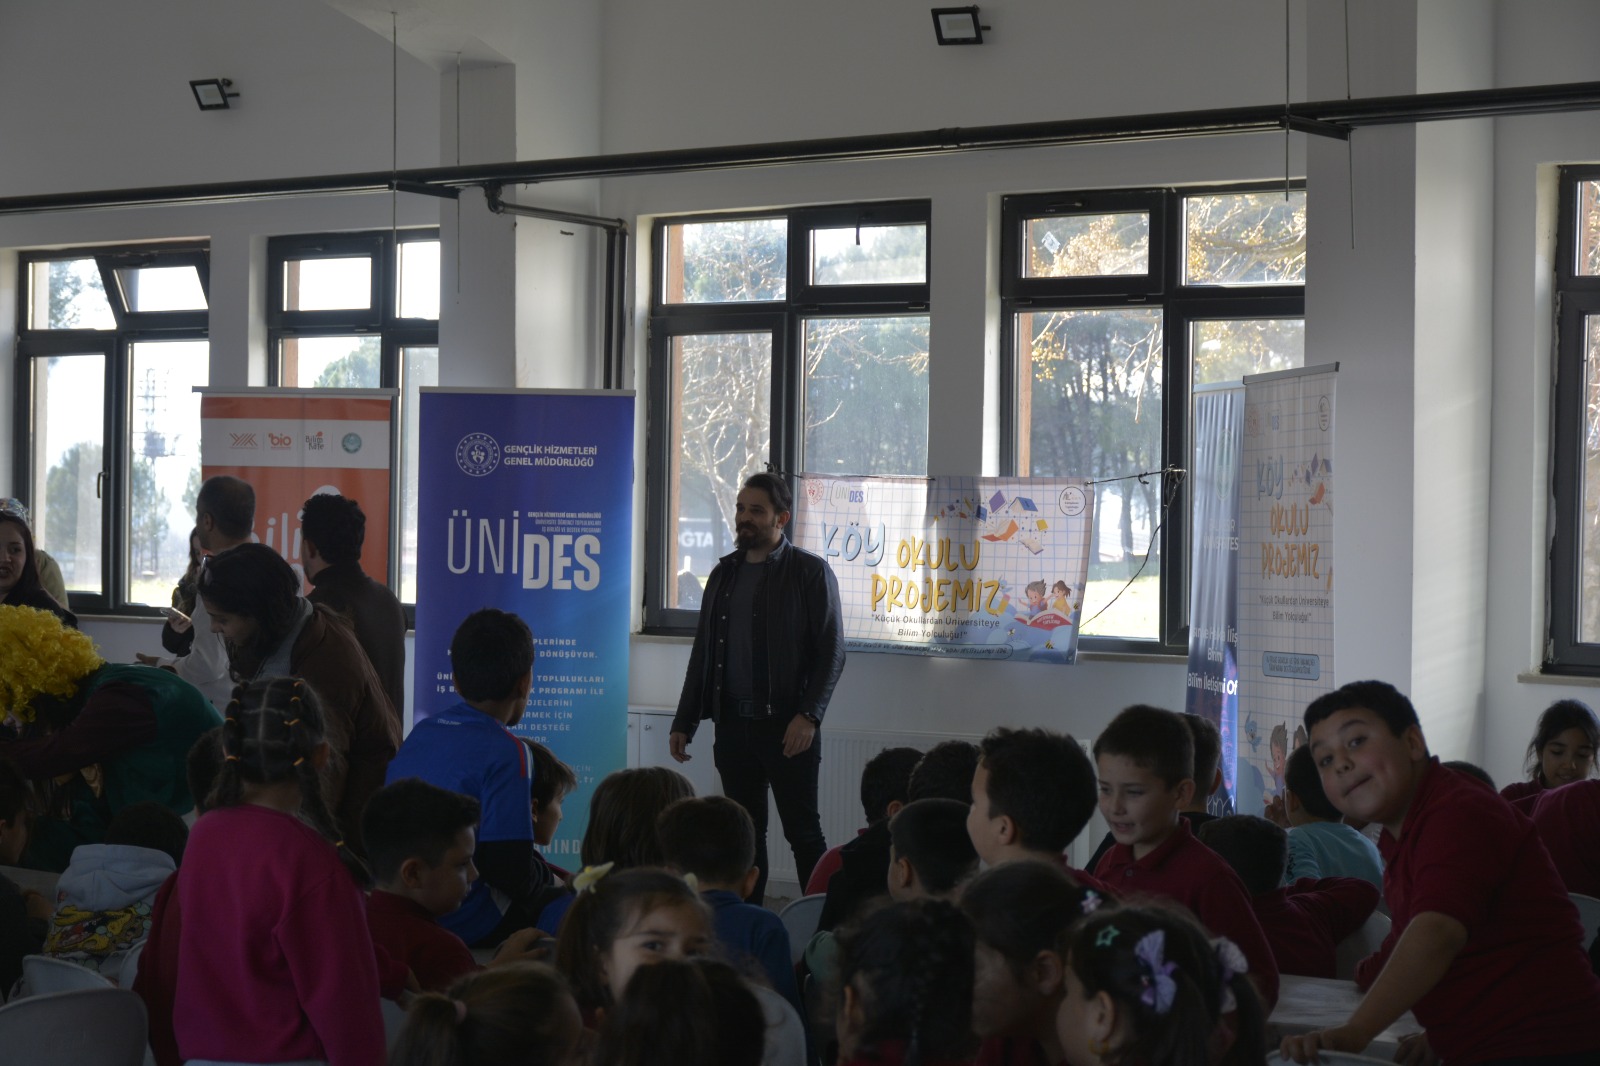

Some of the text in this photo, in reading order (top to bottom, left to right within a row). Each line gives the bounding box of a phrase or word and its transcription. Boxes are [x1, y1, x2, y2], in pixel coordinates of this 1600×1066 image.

[504, 444, 597, 456] GENÇLİK HİZMETLERİ
[504, 457, 594, 467] GENEL MÜDÜRLÜĞÜ
[1256, 455, 1284, 501] KÖY
[1270, 502, 1310, 538] OKULU
[820, 520, 886, 567] KÖY
[896, 535, 981, 573] OKULU
[1261, 542, 1320, 580] PROJEMİZ
[871, 574, 1001, 616] PROJEMİZ
[902, 615, 943, 625] Okullardan
[945, 615, 1001, 629] Üniversiteye
[897, 628, 919, 638] Bilim
[532, 638, 577, 647] PLERİNDE
[539, 650, 598, 660] DÖNÜŞÜYOR.
[536, 674, 605, 683] TOPLULUKLARI
[436, 684, 446, 694] İŞ
[538, 686, 588, 696] PROGRAMI
[589, 686, 605, 695] İLE
[1227, 678, 1238, 696] Of
[526, 699, 574, 708] OJELERİNİ
[553, 710, 574, 720] İÇİN
[529, 723, 572, 732] DESTEĞE
